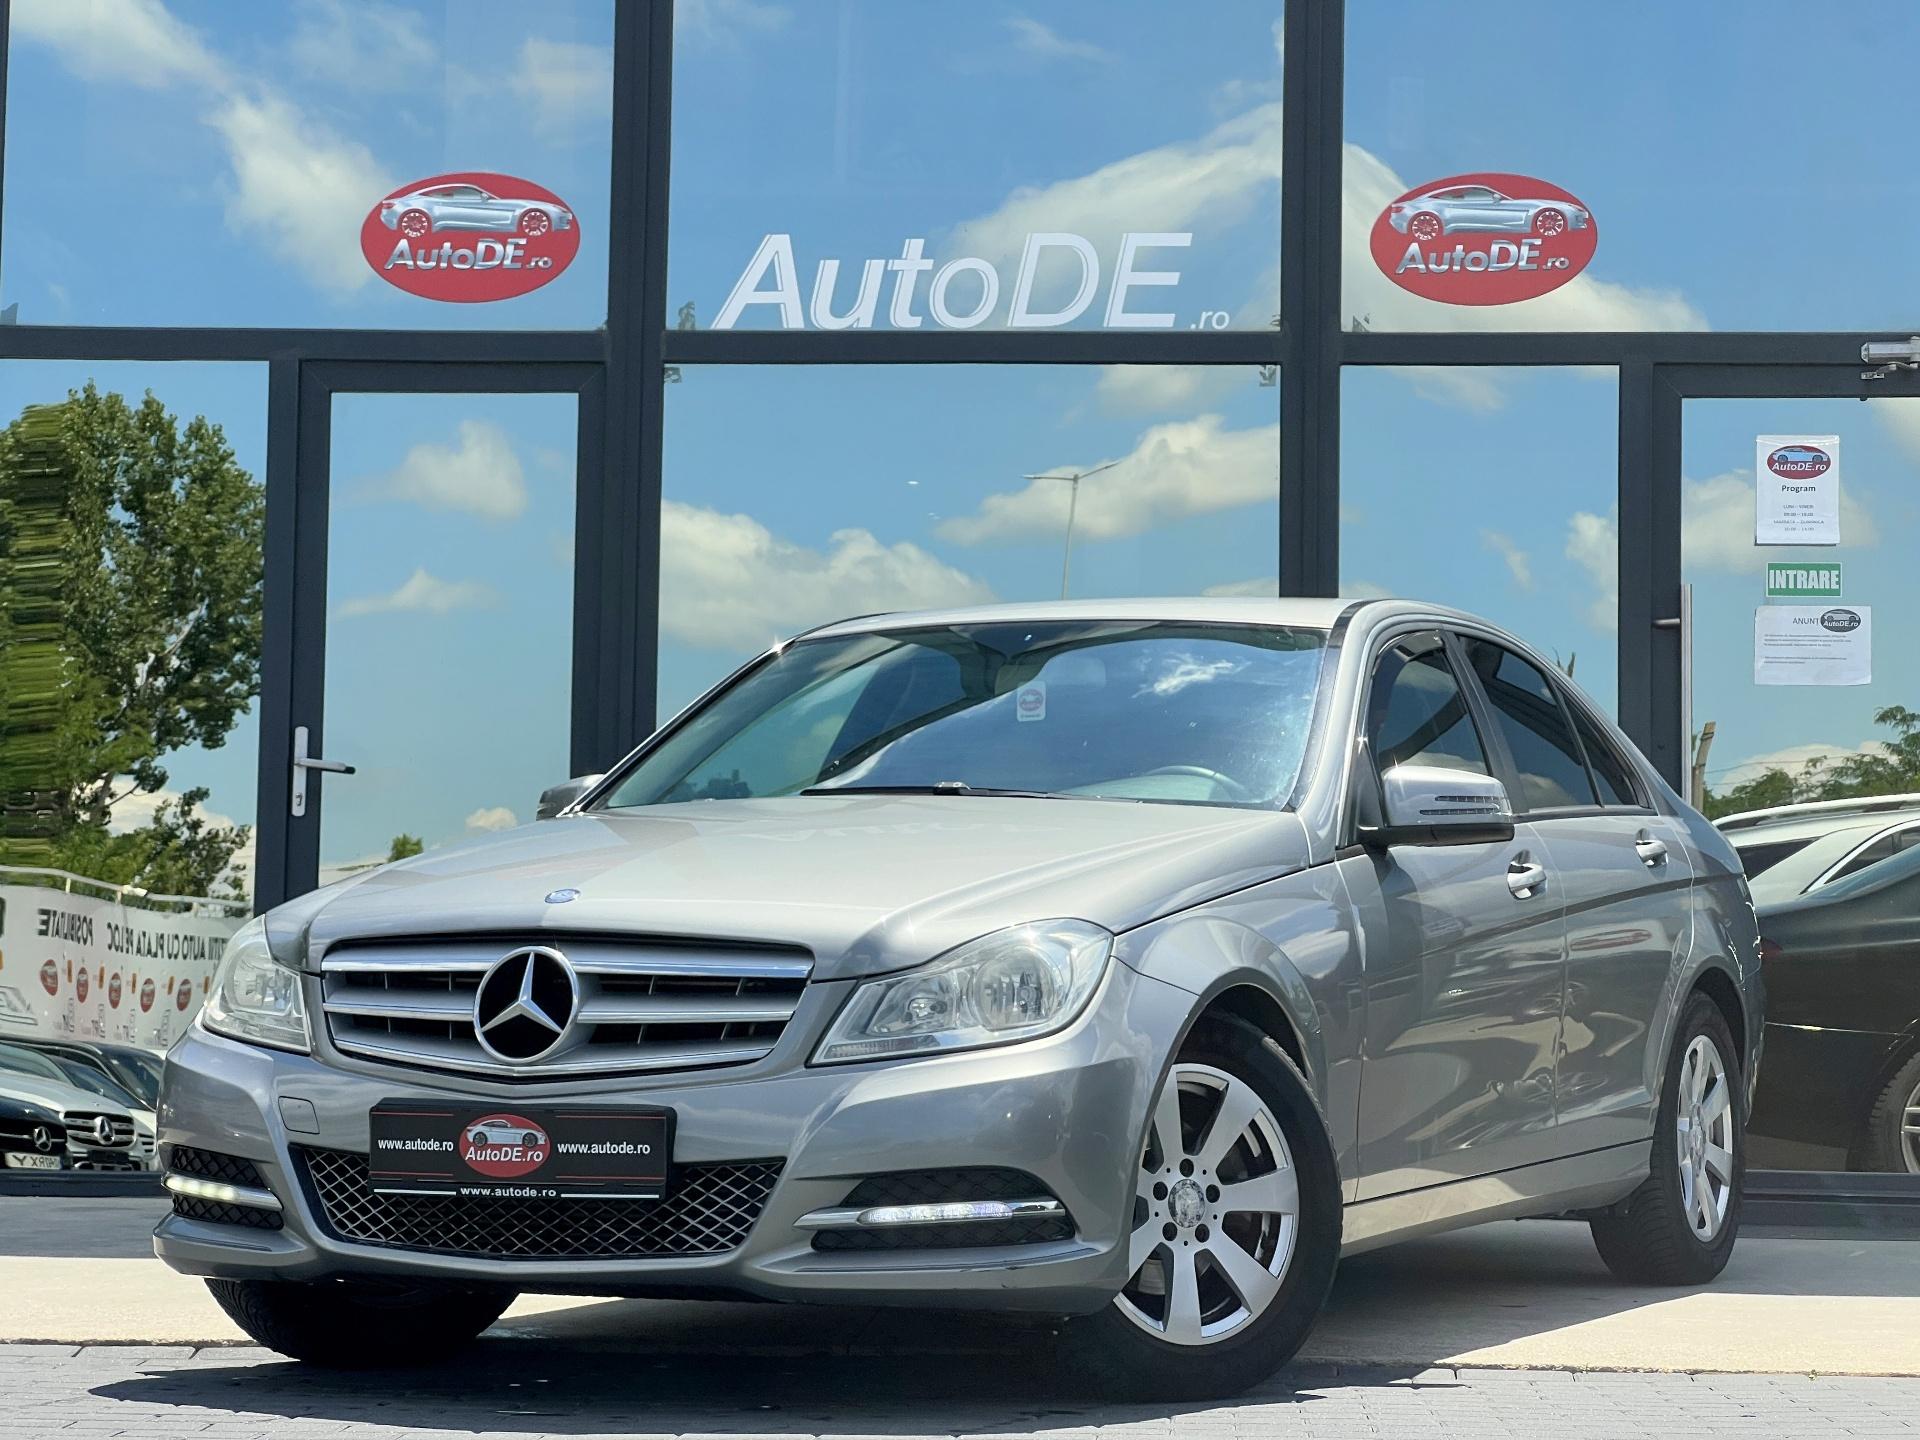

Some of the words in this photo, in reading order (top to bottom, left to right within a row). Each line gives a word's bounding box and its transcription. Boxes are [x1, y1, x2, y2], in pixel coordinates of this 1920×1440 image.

[1772, 462, 1827, 471] AutoDE.ro
[1781, 485, 1816, 493] Program
[1769, 570, 1839, 589] INTRARE
[377, 1137, 454, 1152] www.autode.ro
[464, 1146, 544, 1163] AutoDE.ro
[557, 1141, 651, 1155] www.autode.ro
[460, 1186, 557, 1198] www.autode.ro
